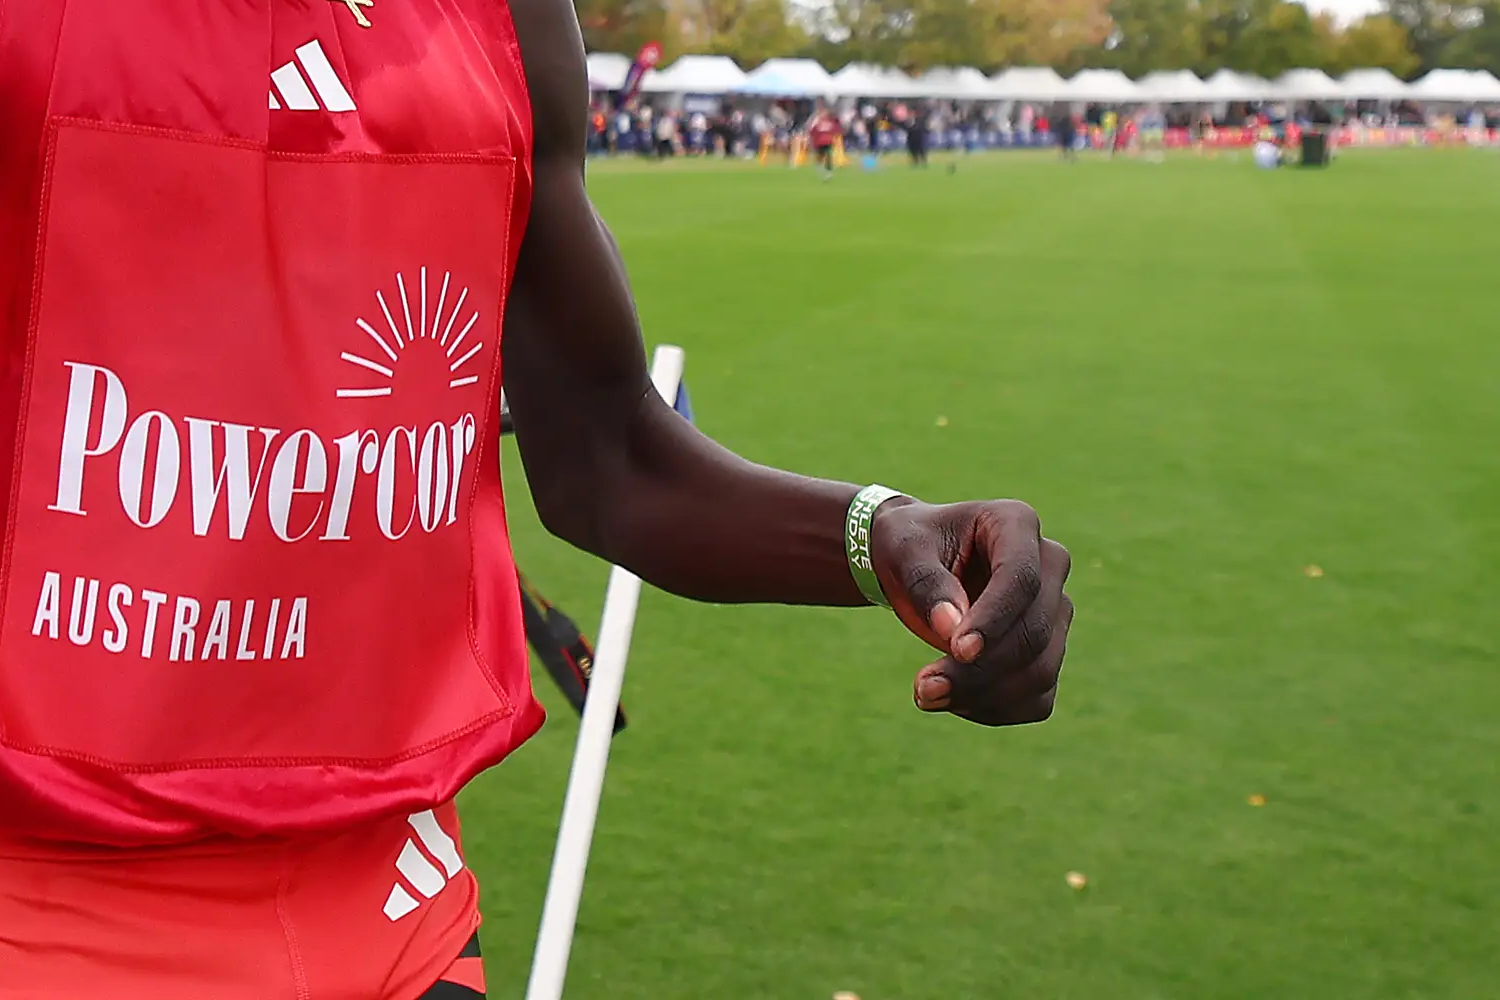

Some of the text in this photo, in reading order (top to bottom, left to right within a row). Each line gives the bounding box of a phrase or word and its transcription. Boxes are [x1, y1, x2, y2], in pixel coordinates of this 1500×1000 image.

[47, 361, 477, 542] Powercor
[848, 490, 874, 569] ONDAY
[32, 571, 307, 661] AUSTRALIA
